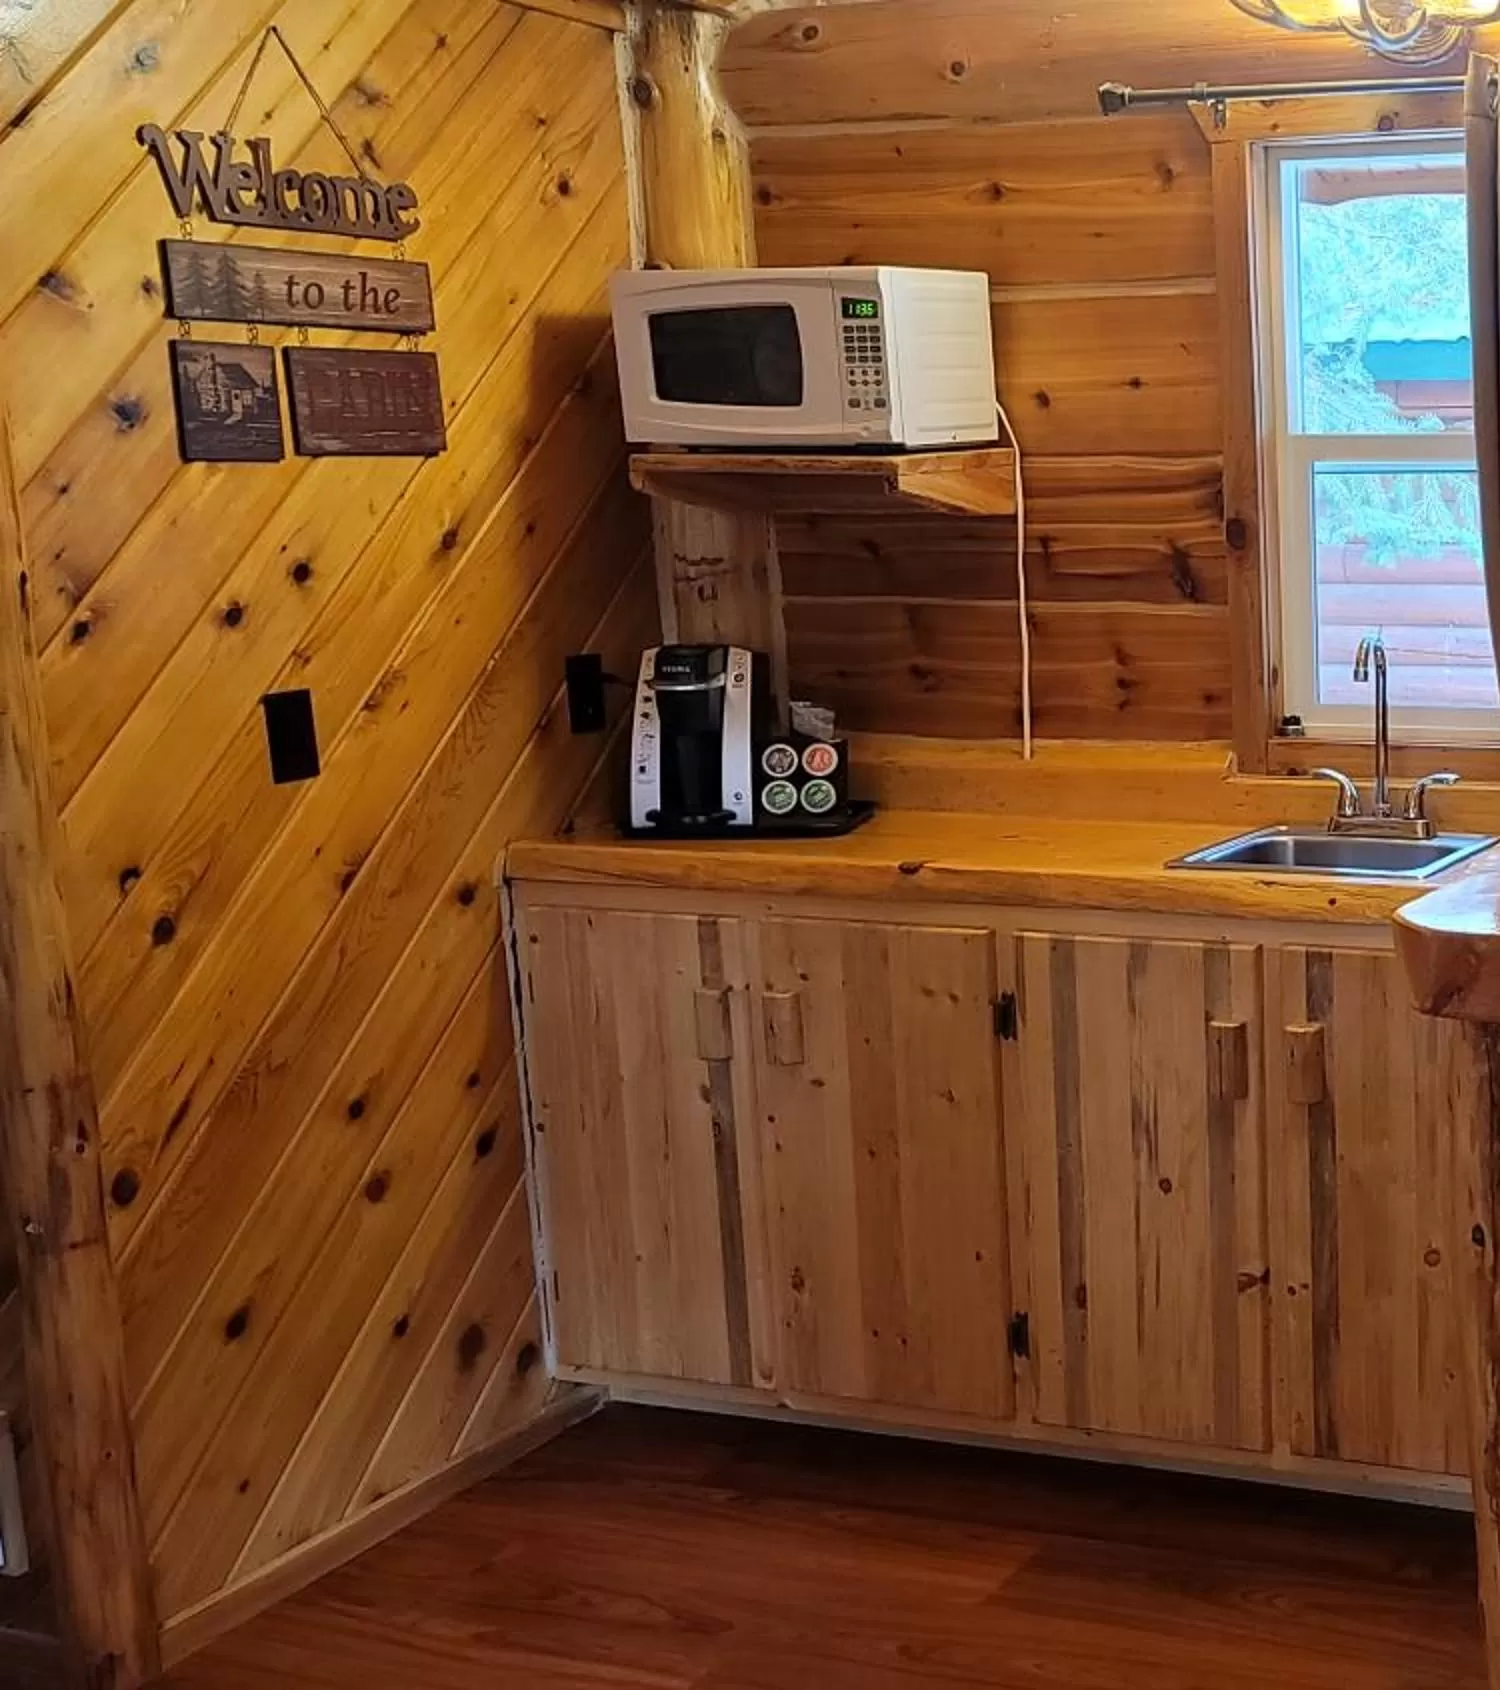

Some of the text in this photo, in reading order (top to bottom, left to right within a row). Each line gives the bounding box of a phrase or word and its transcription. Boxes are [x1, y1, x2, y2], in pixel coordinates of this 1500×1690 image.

[136, 124, 421, 242] Welcome
[284, 271, 401, 315] to the
